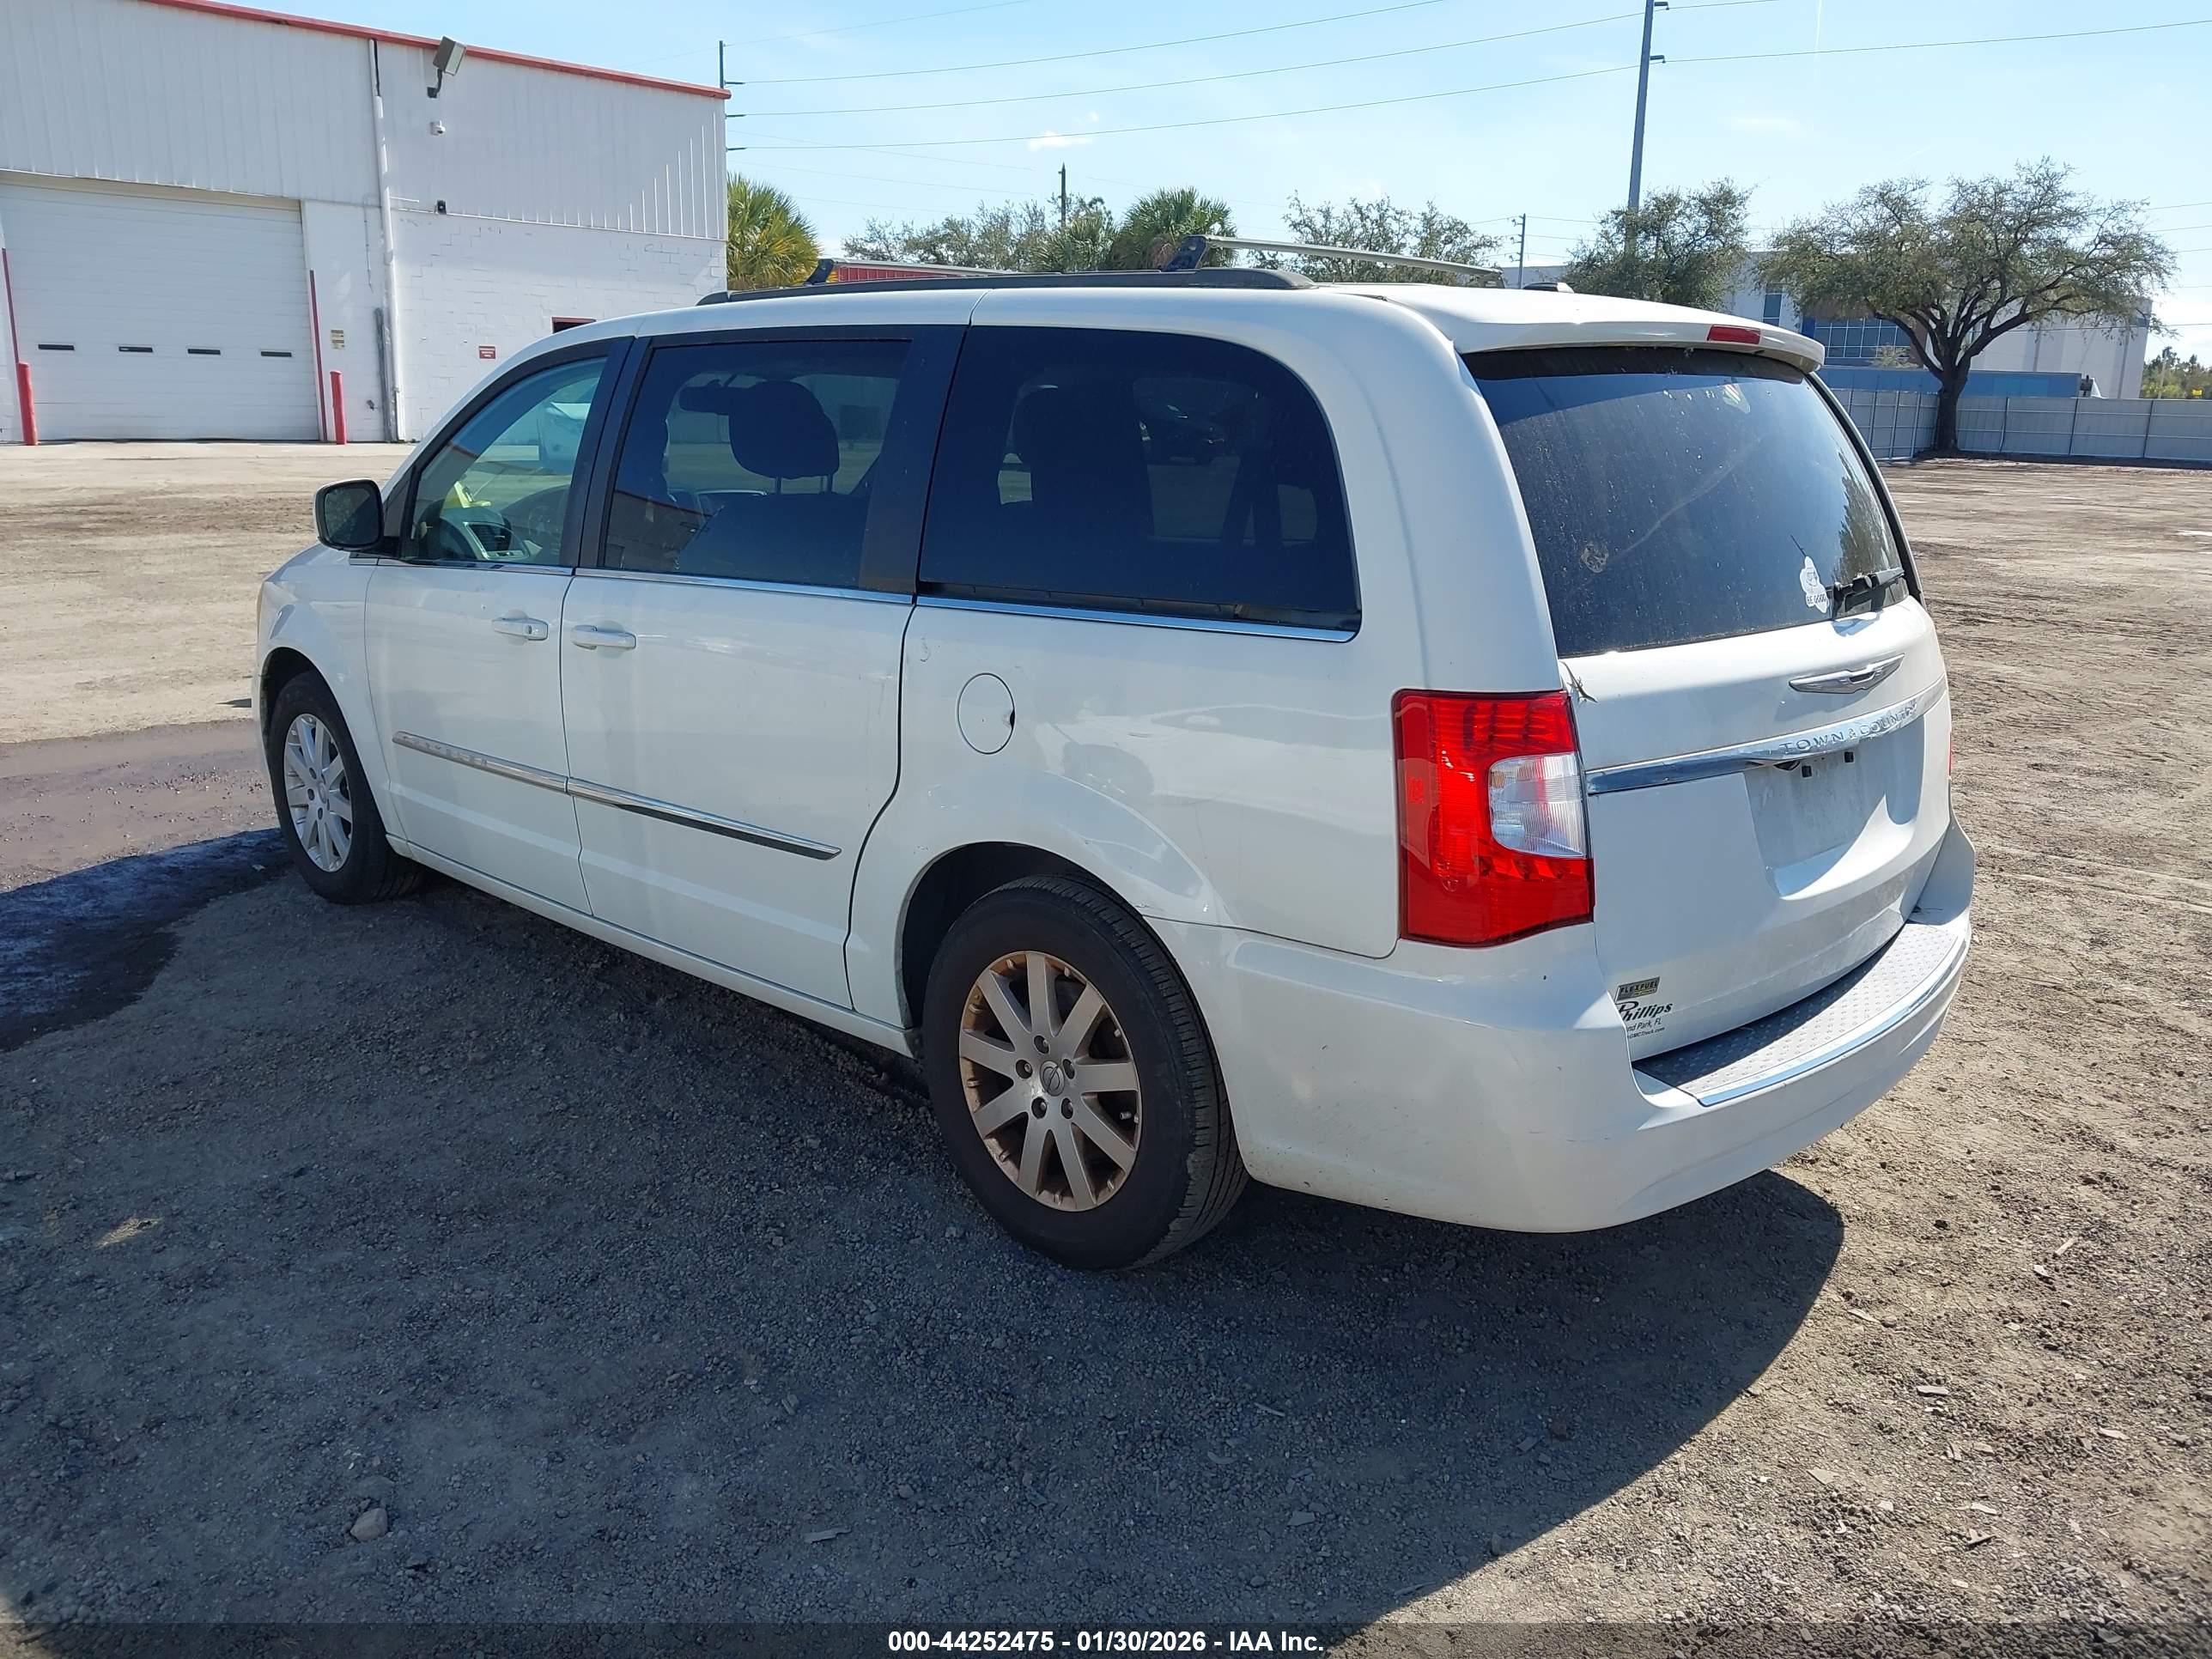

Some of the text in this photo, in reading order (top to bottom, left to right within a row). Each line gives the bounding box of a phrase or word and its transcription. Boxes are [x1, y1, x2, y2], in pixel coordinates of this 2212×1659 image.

[1778, 731, 1844, 755] TOWN
[1860, 700, 1918, 736] COUNTRY
[1615, 1000, 1673, 1022] Phillips
